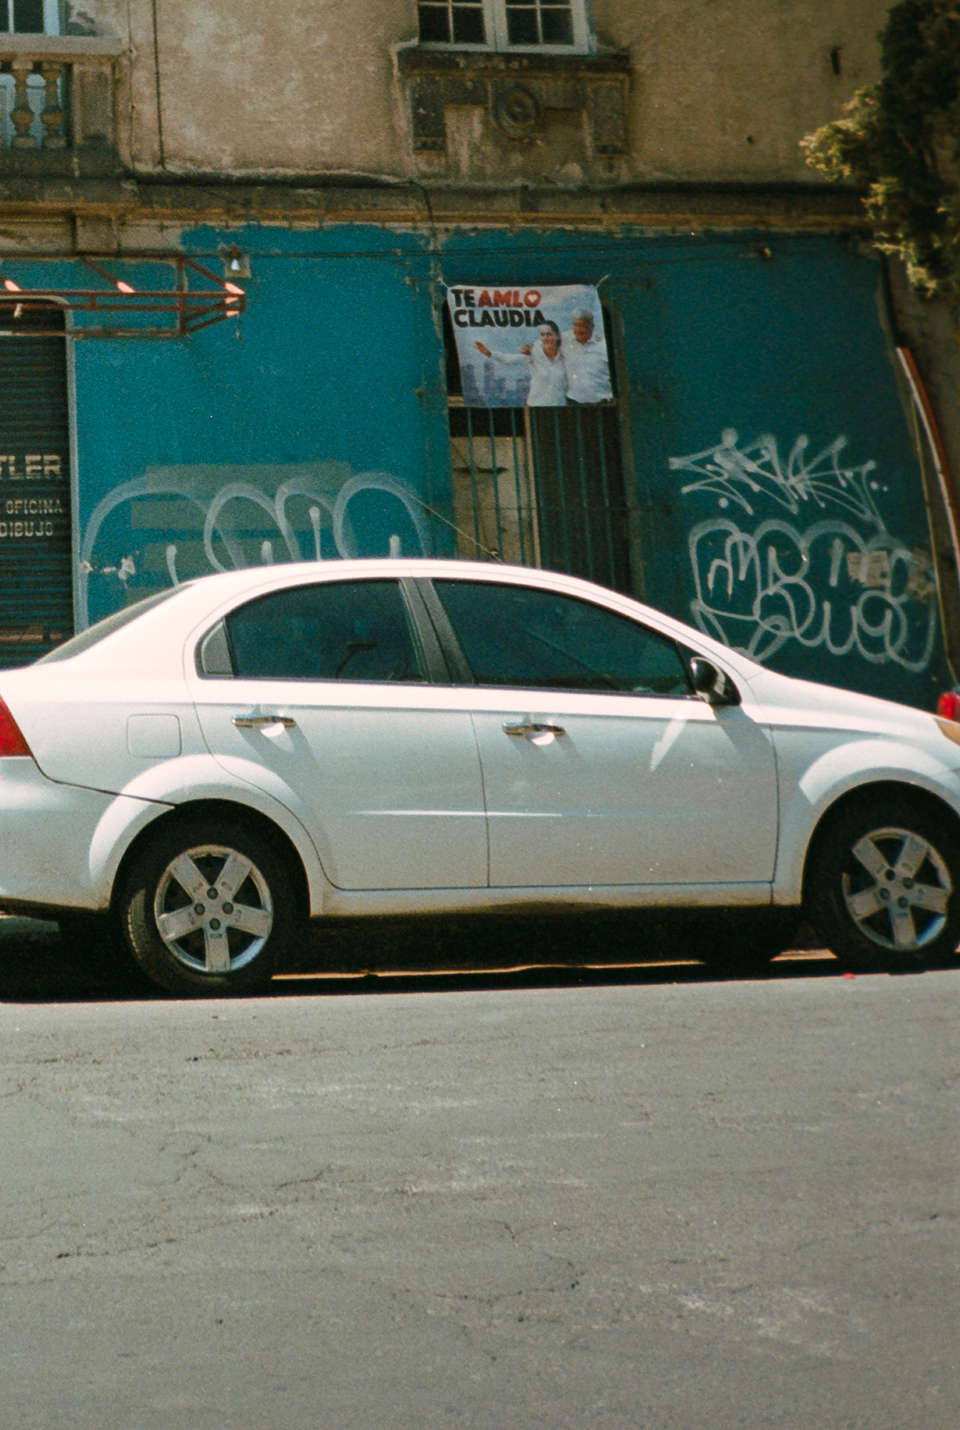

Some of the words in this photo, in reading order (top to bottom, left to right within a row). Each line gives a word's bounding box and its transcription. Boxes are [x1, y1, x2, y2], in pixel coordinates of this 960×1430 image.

[450, 289, 475, 308] TE
[478, 289, 542, 308] AMLO
[453, 309, 546, 328] CLAUDIA
[5, 498, 63, 515] OFICINA
